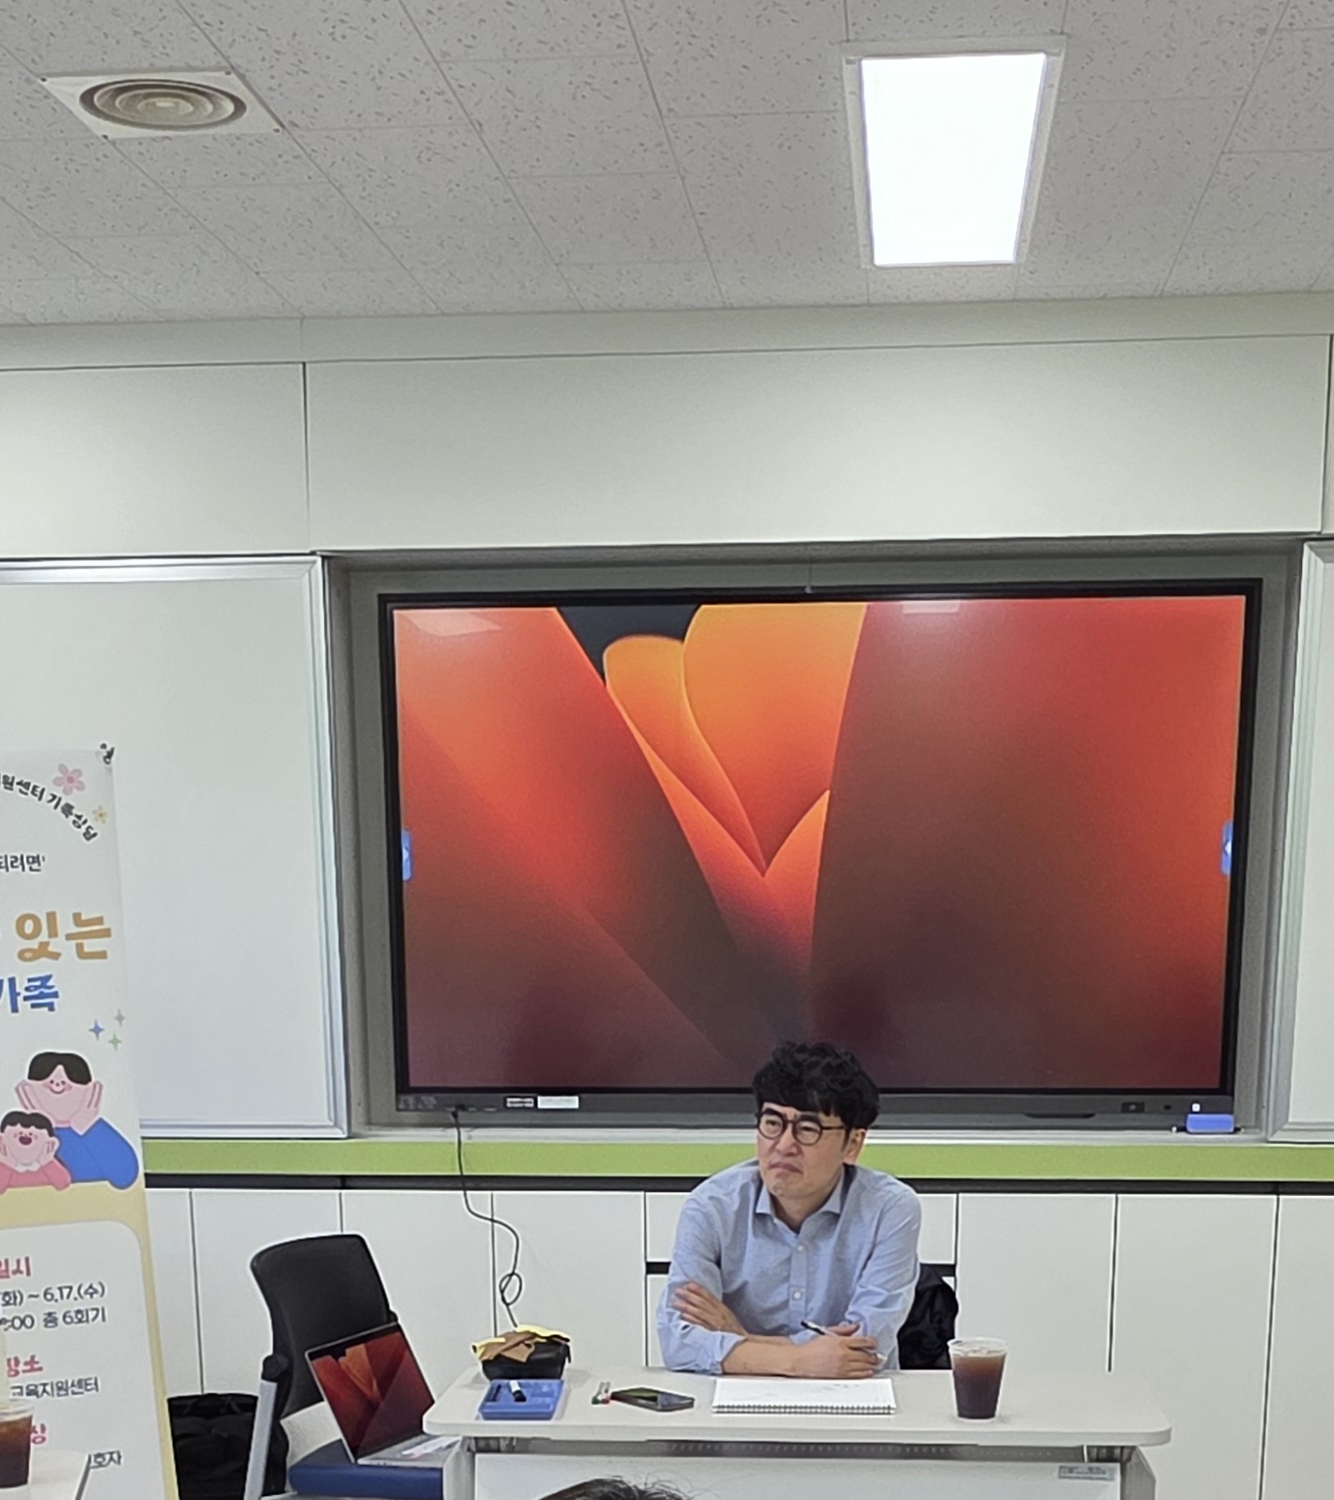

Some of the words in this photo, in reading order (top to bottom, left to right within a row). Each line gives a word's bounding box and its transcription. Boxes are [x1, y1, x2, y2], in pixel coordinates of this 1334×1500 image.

[14, 910, 113, 964] 잇는
[43, 1281, 107, 1303] 6.17.(수)
[62, 1306, 106, 1325] 6회기
